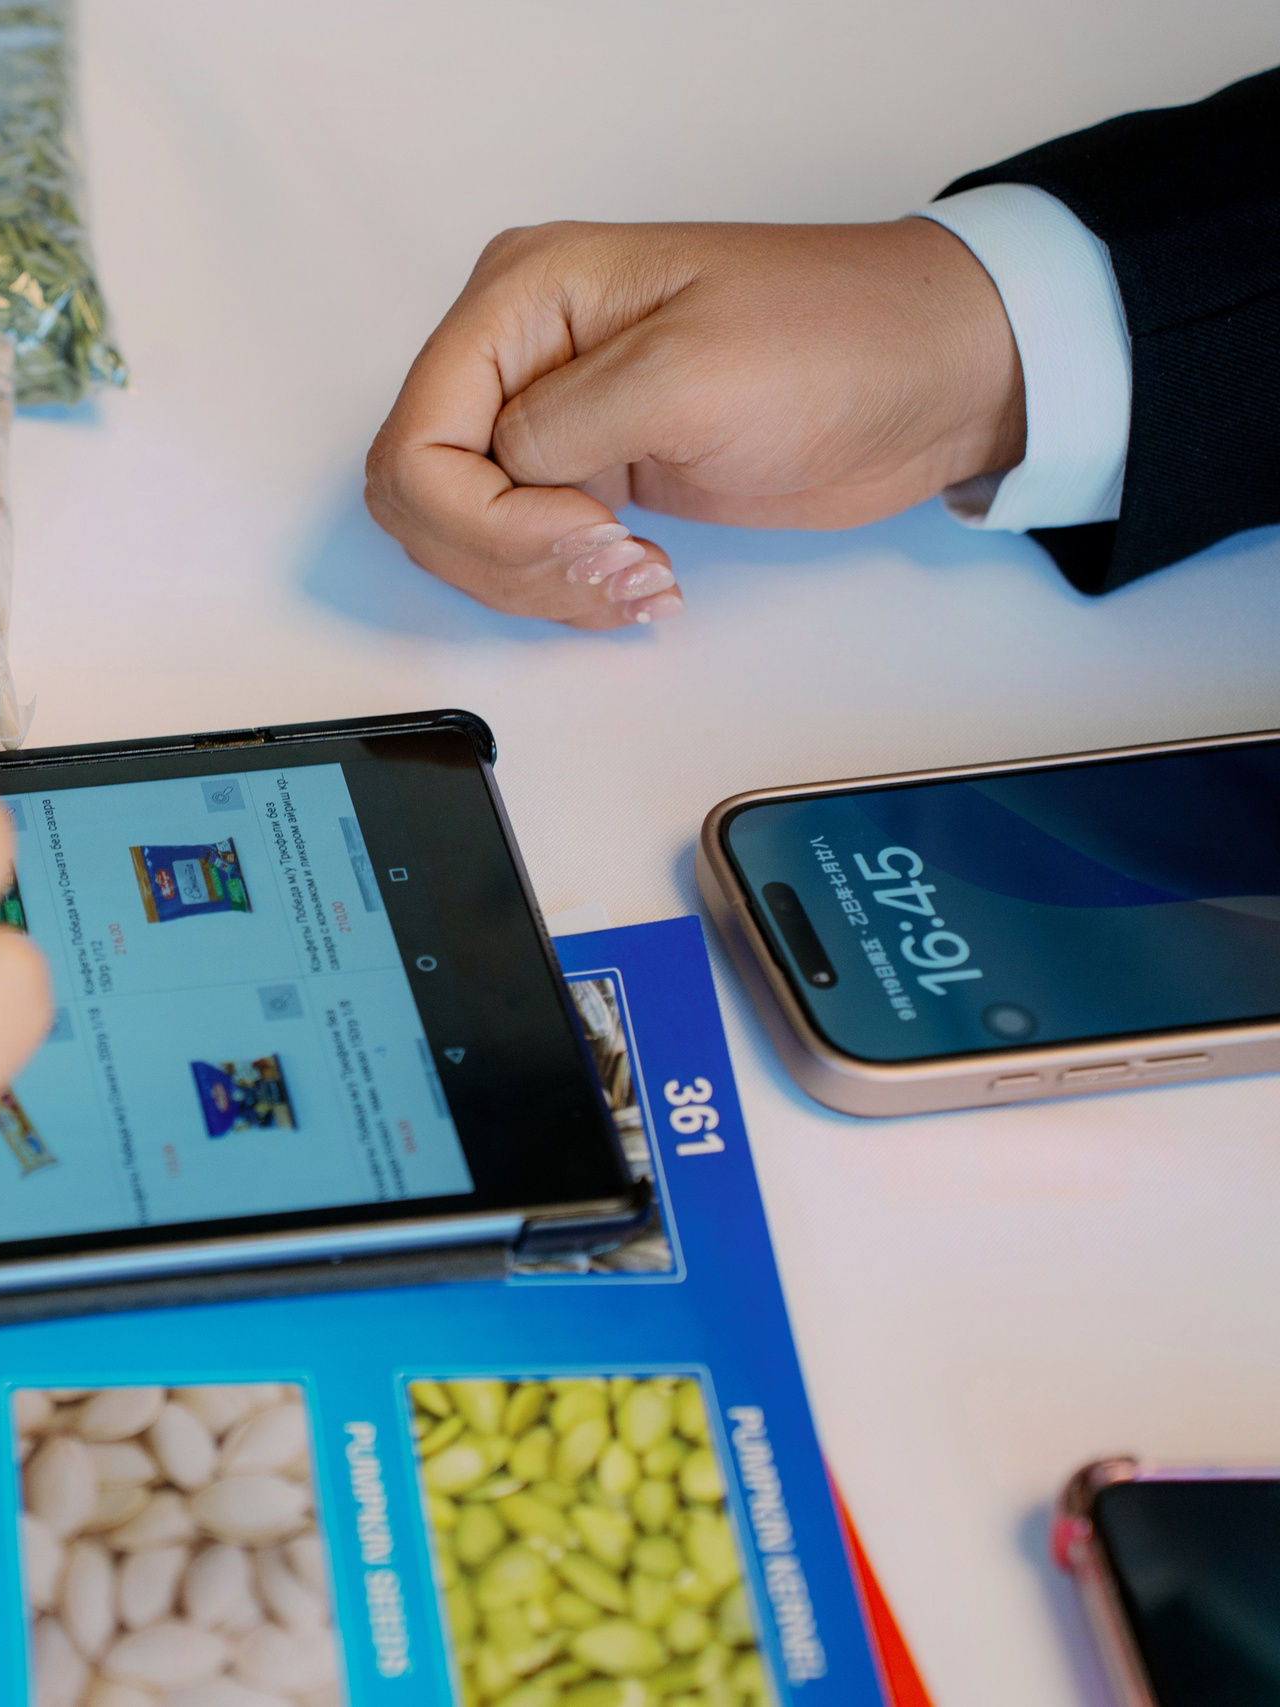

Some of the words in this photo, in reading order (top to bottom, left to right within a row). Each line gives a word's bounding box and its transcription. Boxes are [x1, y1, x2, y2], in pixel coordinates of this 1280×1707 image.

[42, 799, 58, 832] сахара
[266, 802, 277, 819] без
[281, 792, 297, 823] айриш
[50, 833, 62, 850] без
[271, 820, 293, 866] Трюфели
[291, 824, 310, 867] ликером
[55, 852, 71, 888] Соната
[284, 867, 298, 884] м/у
[62, 888, 75, 907] м/у
[291, 886, 308, 924] Победа
[306, 878, 326, 926] коньяком
[332, 901, 352, 933] 210,00
[69, 907, 84, 946] Победа
[853, 846, 984, 996] 16:45
[302, 925, 322, 973] Конфеты
[324, 935, 341, 971] сахара
[78, 948, 95, 996] Конфеты
[663, 1077, 726, 1157] 361
[344, 1421, 395, 1565] PUMPKIN
[727, 1405, 796, 1554] PUMPKIN
[762, 1554, 828, 1687] KERNEL
[364, 1567, 411, 1679] SEEDS
